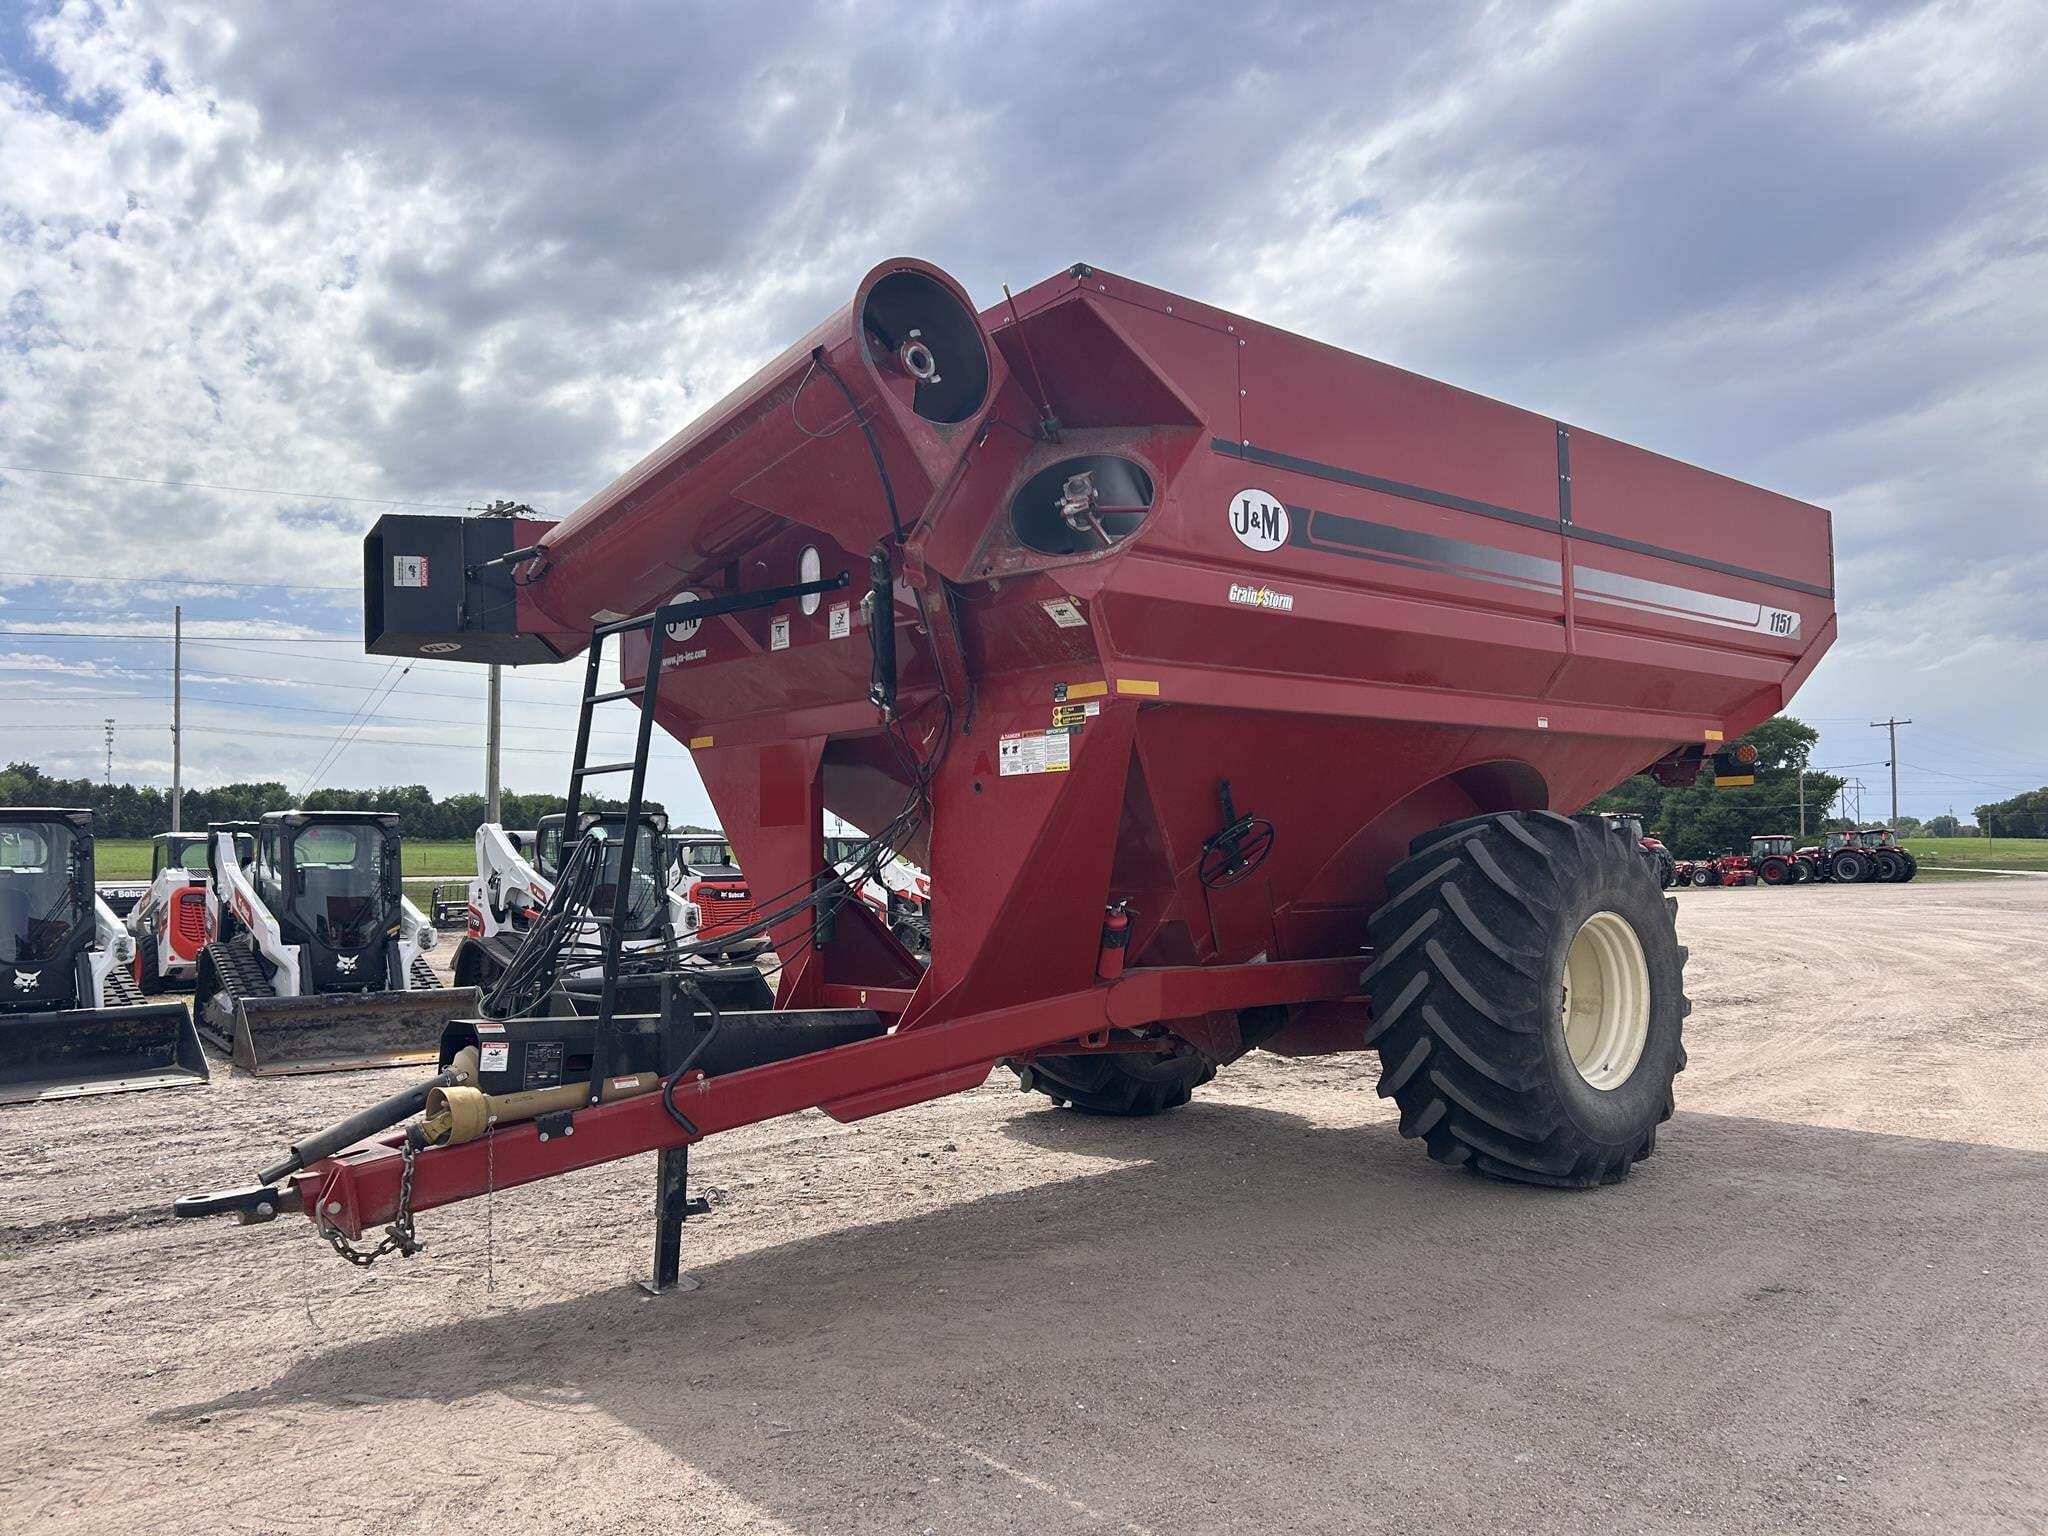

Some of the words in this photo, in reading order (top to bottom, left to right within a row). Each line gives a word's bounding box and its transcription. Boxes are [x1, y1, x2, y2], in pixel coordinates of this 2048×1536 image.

[1233, 499, 1280, 542] J&M
[1229, 584, 1258, 606] Grain
[1262, 589, 1294, 611] Storm
[1770, 612, 1792, 634] 1151
